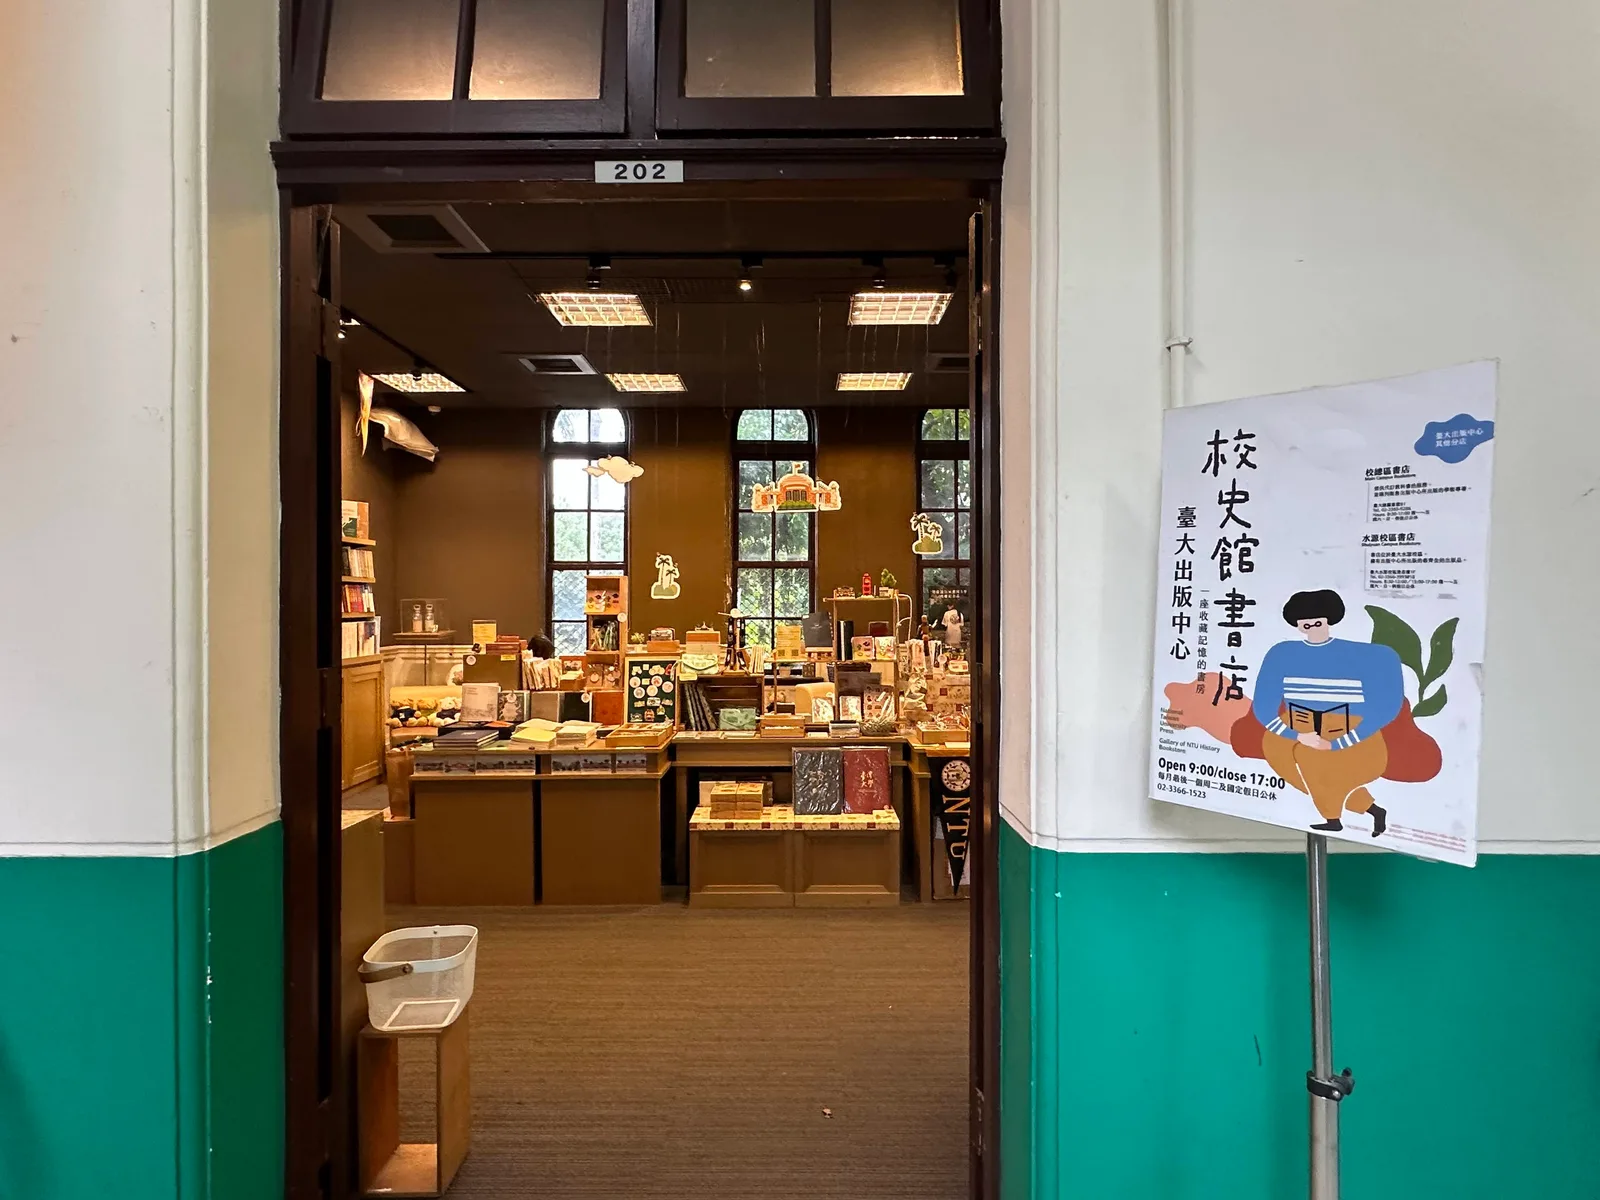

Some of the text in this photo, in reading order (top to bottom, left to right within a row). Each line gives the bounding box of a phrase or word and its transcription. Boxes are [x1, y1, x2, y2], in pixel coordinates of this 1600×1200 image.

[614, 163, 666, 180] 202
[1365, 465, 1411, 477] 校總區書店
[1362, 532, 1415, 542] 水源校區書店
[1201, 428, 1260, 706] 校史館書店
[1170, 506, 1197, 661] 臺大出版中心
[1195, 590, 1210, 695] 一座收藏記憶的書房
[1160, 707, 1183, 716] National
[1160, 713, 1179, 722] Taiwan
[1160, 720, 1187, 730] University
[1159, 738, 1179, 747] Gallery
[1200, 744, 1220, 753] History
[1159, 745, 1186, 754] Bookstore
[1158, 757, 1286, 790] Open 9:00/close 17:00
[1157, 783, 1207, 799] 02-3366-1523
[1158, 771, 1278, 801] 每月最後一個周二及國定假日公休
[942, 795, 970, 860] NTU
